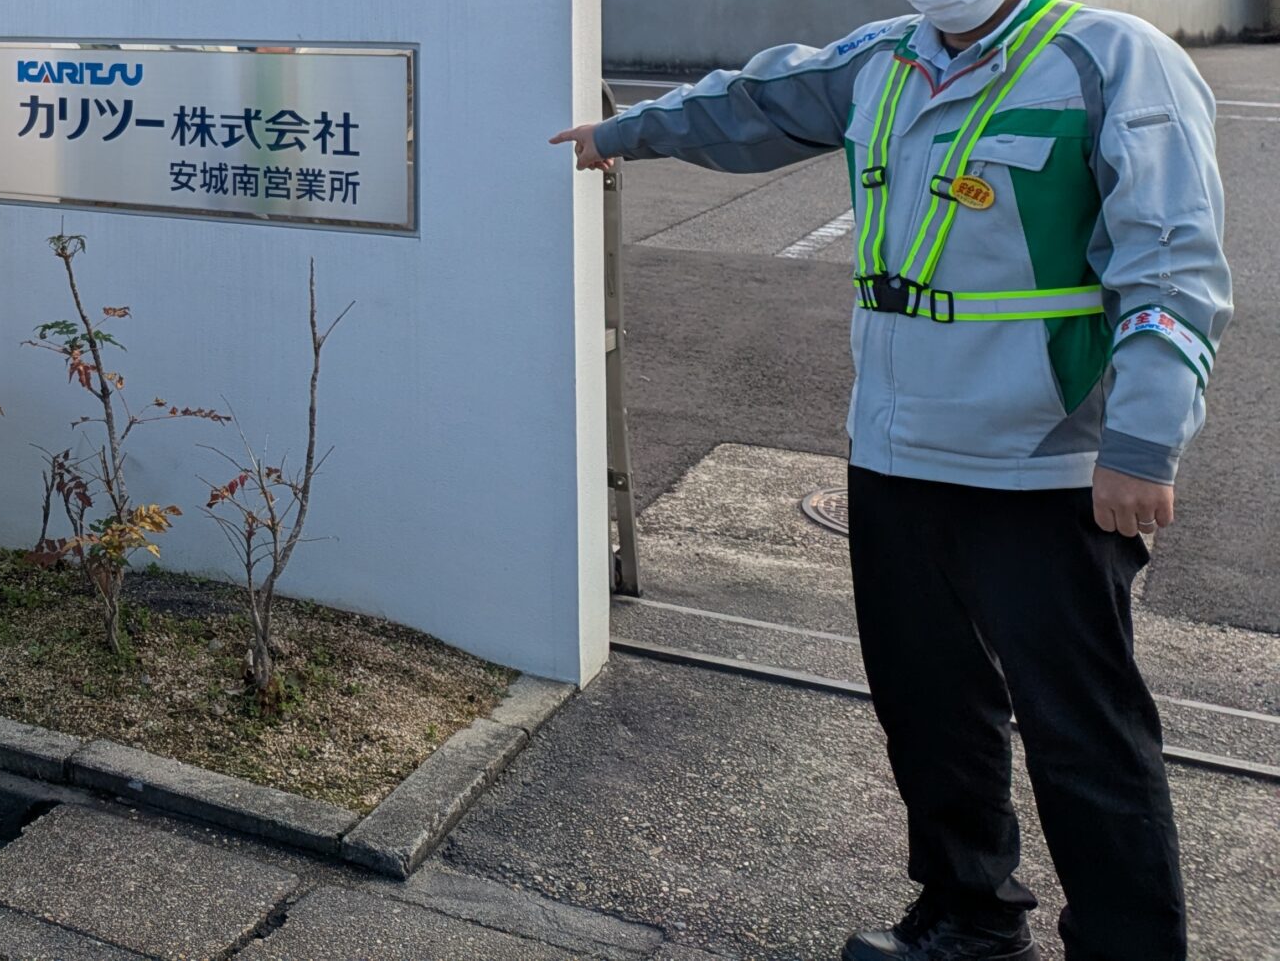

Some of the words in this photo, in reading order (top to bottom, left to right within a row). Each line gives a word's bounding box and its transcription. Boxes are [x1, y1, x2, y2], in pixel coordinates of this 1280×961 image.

[17, 60, 144, 86] KARITSU
[17, 95, 360, 157] カリツー株式会社
[168, 160, 361, 205] 安城南営業所
